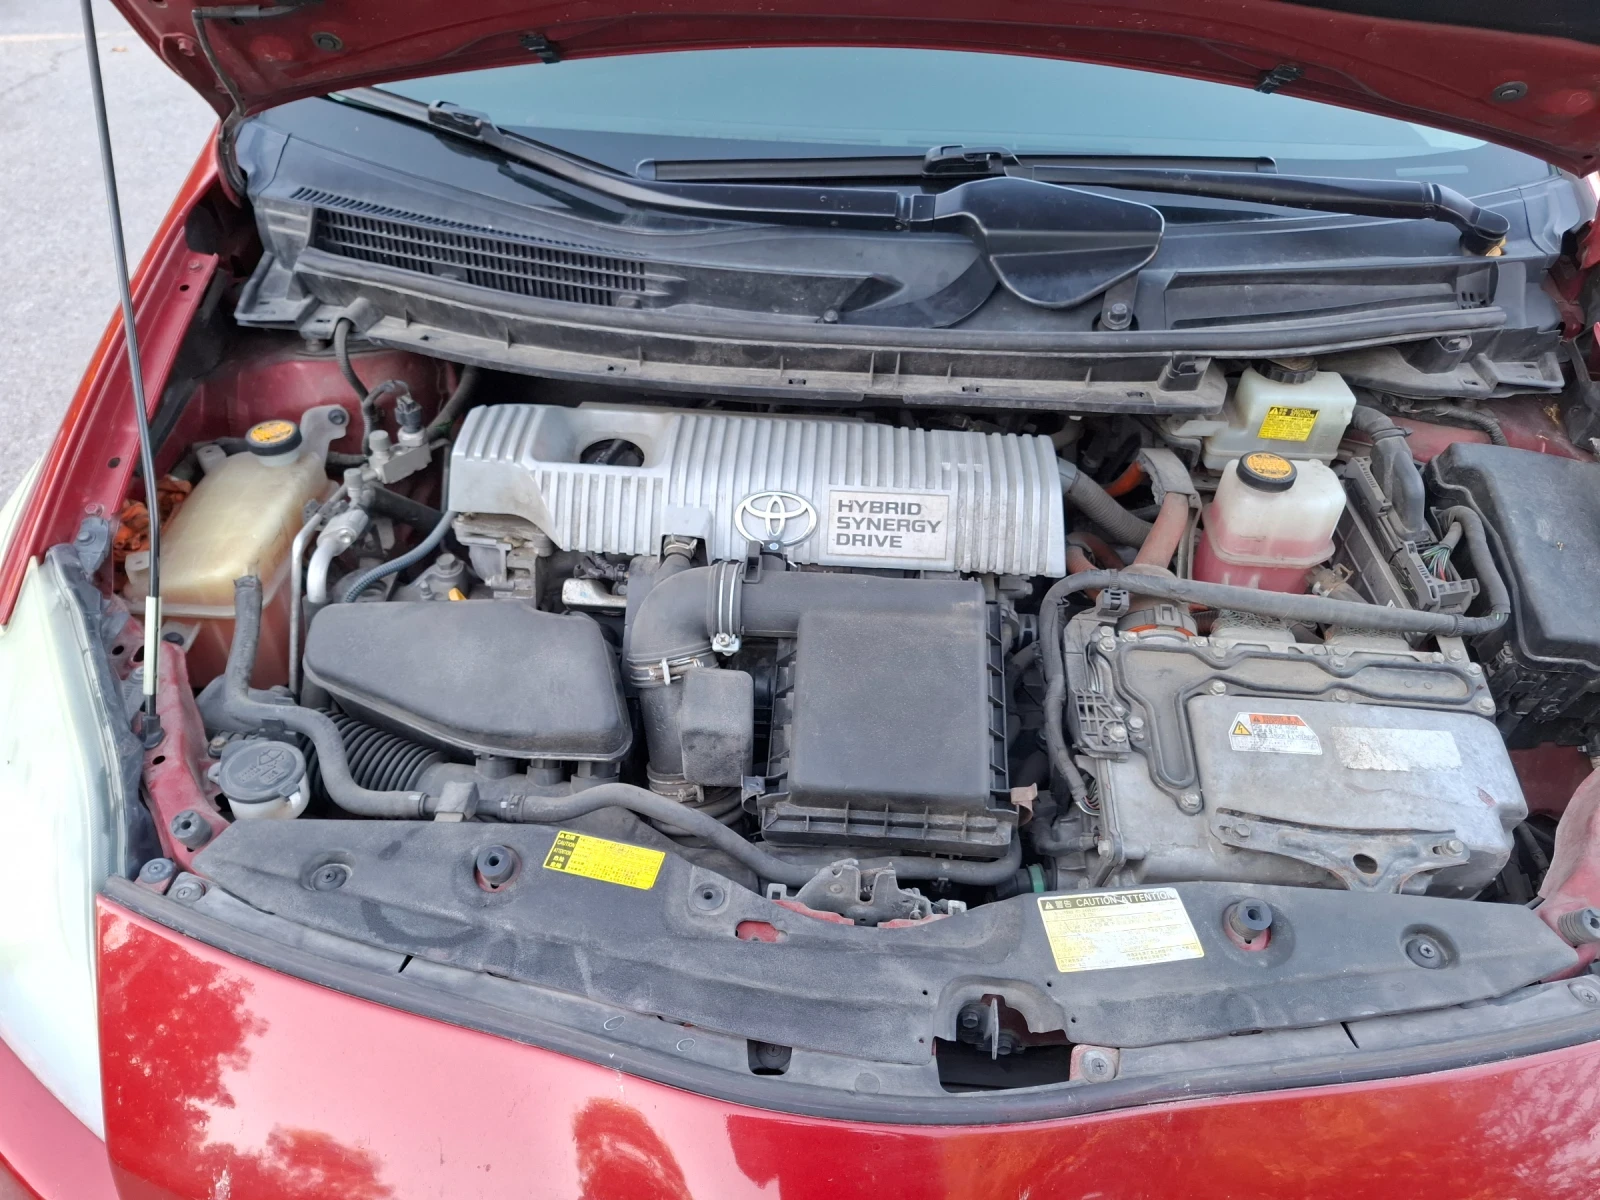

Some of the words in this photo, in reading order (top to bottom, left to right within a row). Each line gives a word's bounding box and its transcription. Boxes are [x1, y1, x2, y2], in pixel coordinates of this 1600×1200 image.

[838, 499, 922, 516] HYBRID
[836, 516, 942, 534] SYNERGY
[836, 533, 903, 548] DRIVE
[1076, 896, 1116, 907] CAUTION
[1120, 891, 1175, 904] ATTENTION
